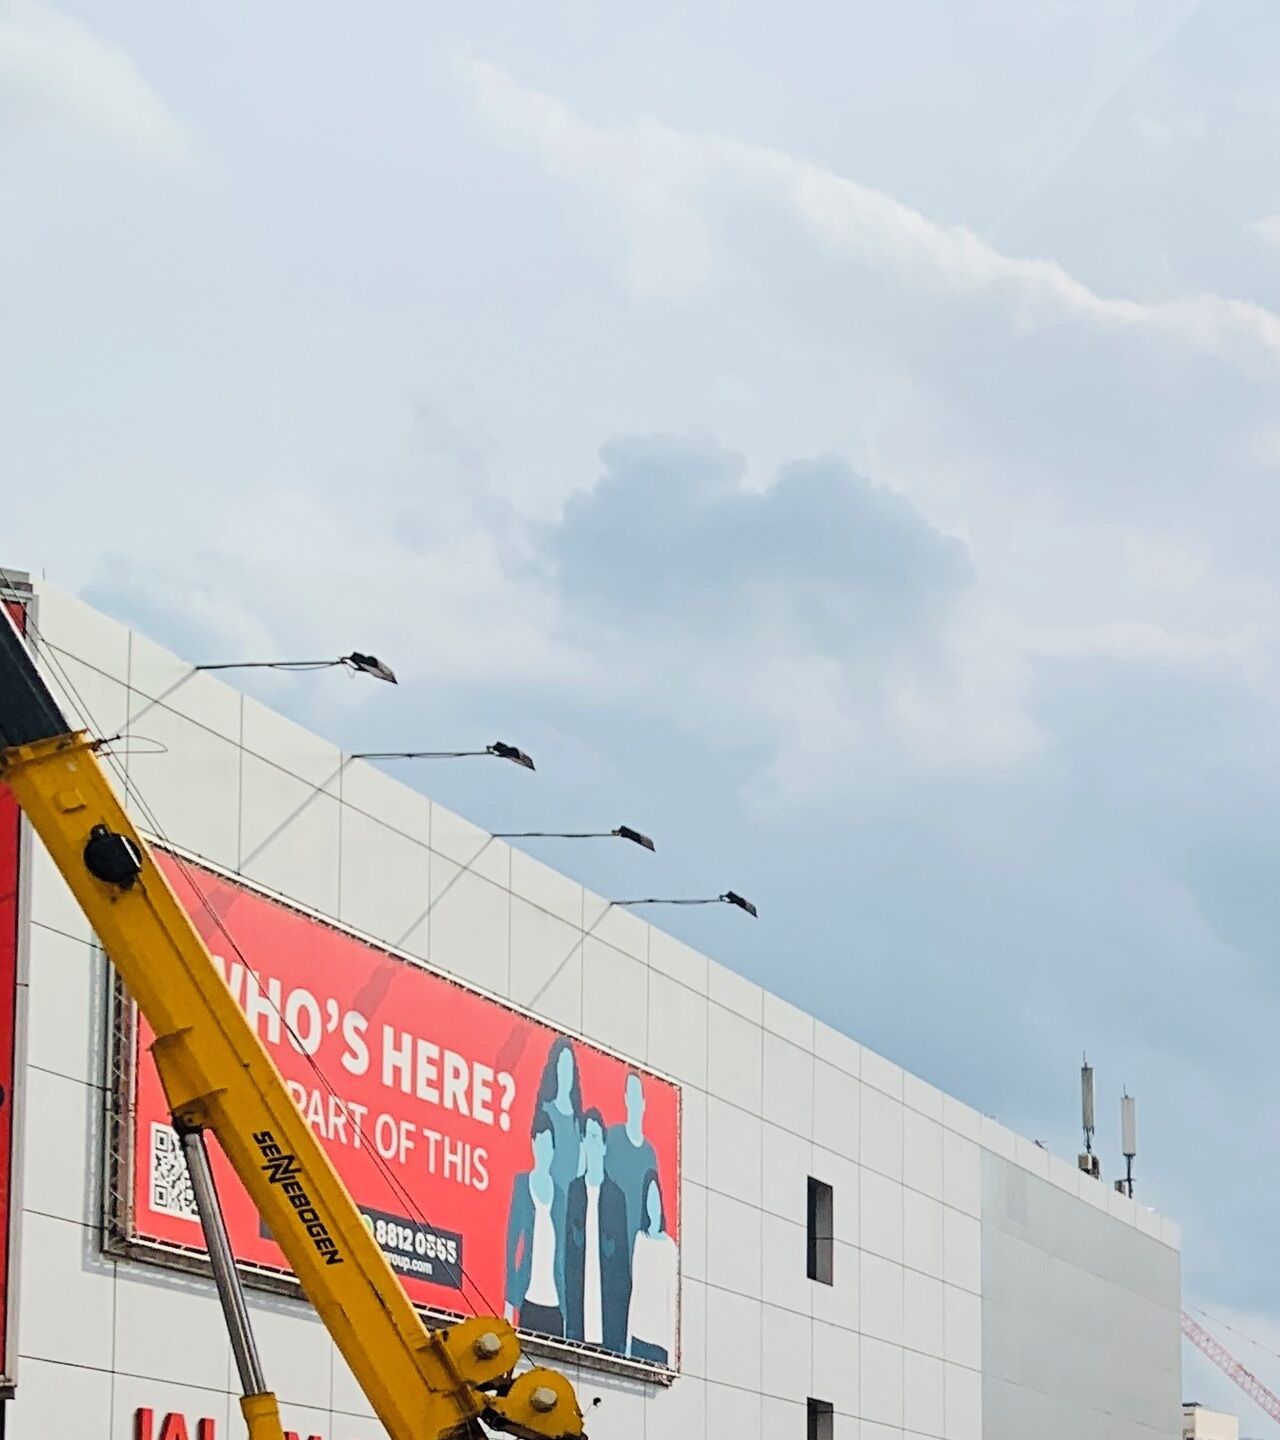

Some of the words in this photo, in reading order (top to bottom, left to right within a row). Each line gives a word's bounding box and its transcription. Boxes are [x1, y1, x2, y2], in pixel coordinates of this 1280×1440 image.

[382, 1024, 516, 1132] HERE?
[375, 1113, 417, 1164] OF
[422, 1128, 490, 1192] THIS
[375, 1220, 414, 1252] 8812
